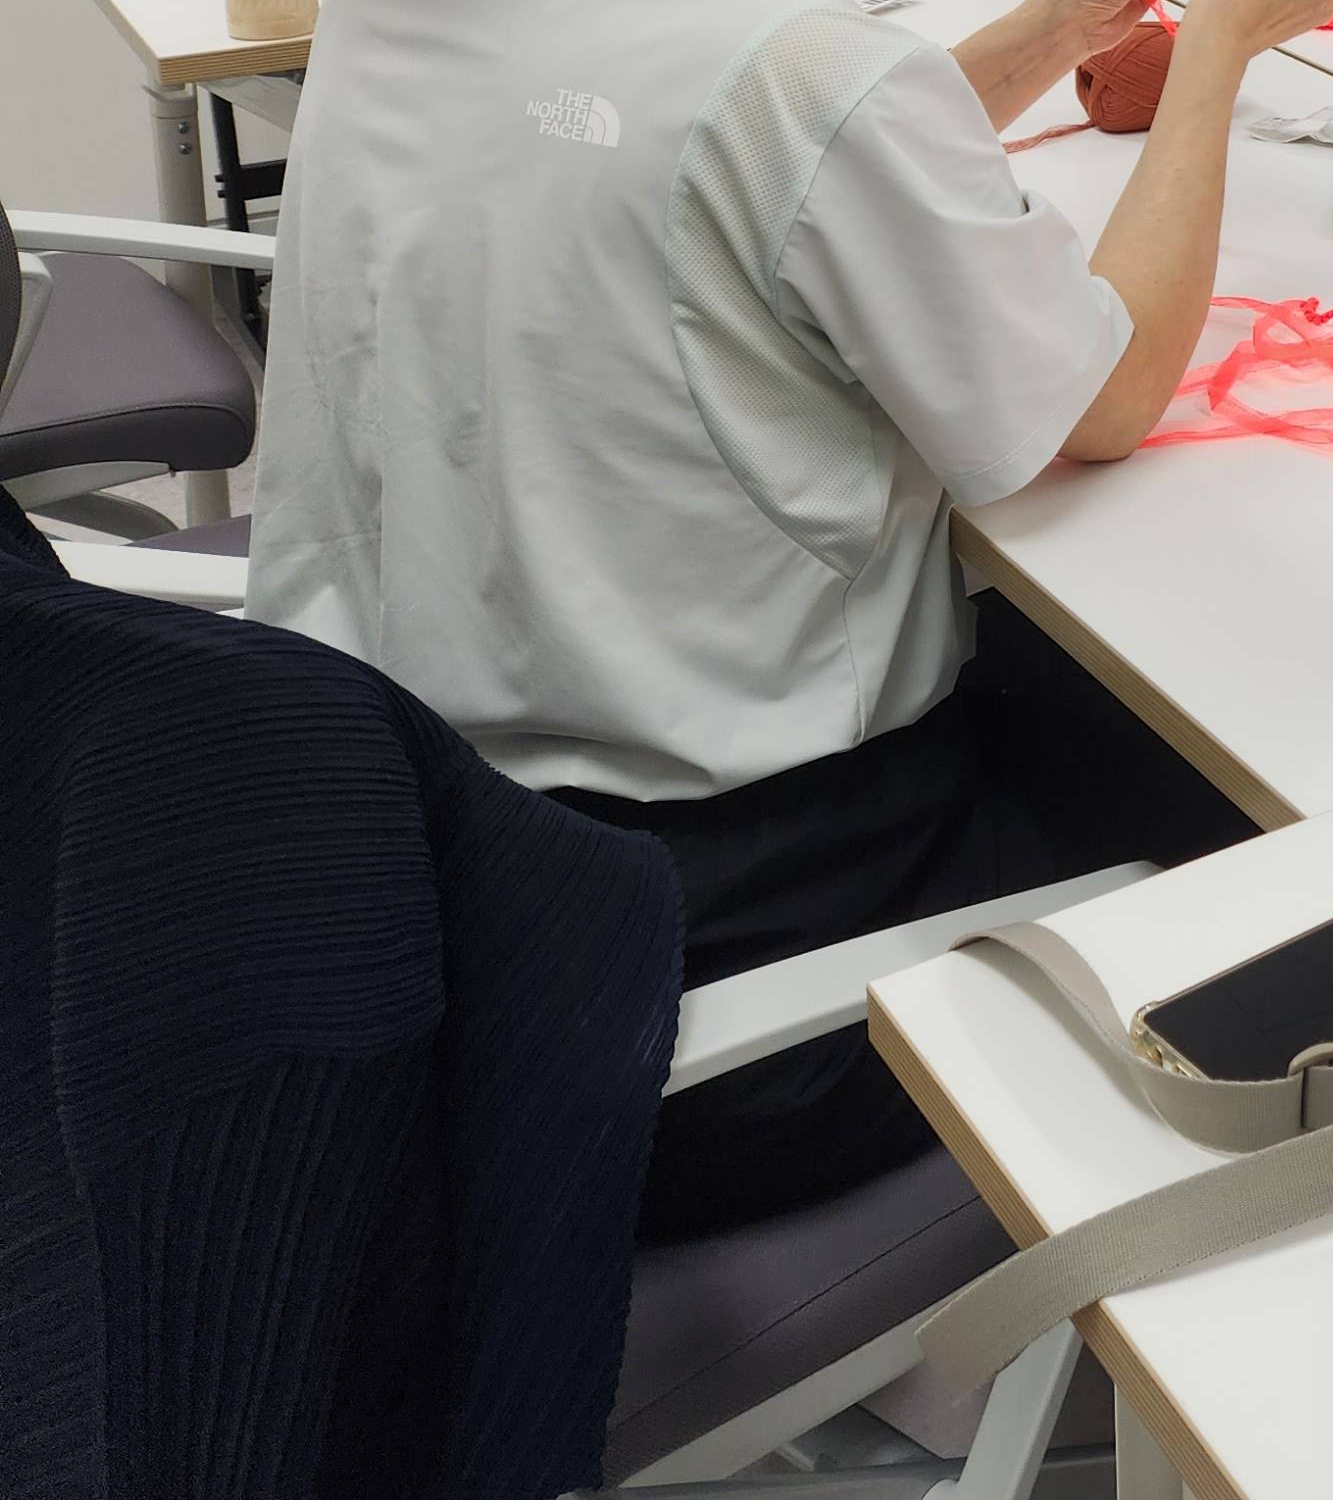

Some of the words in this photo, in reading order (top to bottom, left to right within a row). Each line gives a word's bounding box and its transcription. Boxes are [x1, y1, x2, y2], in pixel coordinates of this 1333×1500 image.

[556, 88, 594, 110] THE
[526, 100, 589, 126] NORTH
[539, 118, 586, 141] FACE
